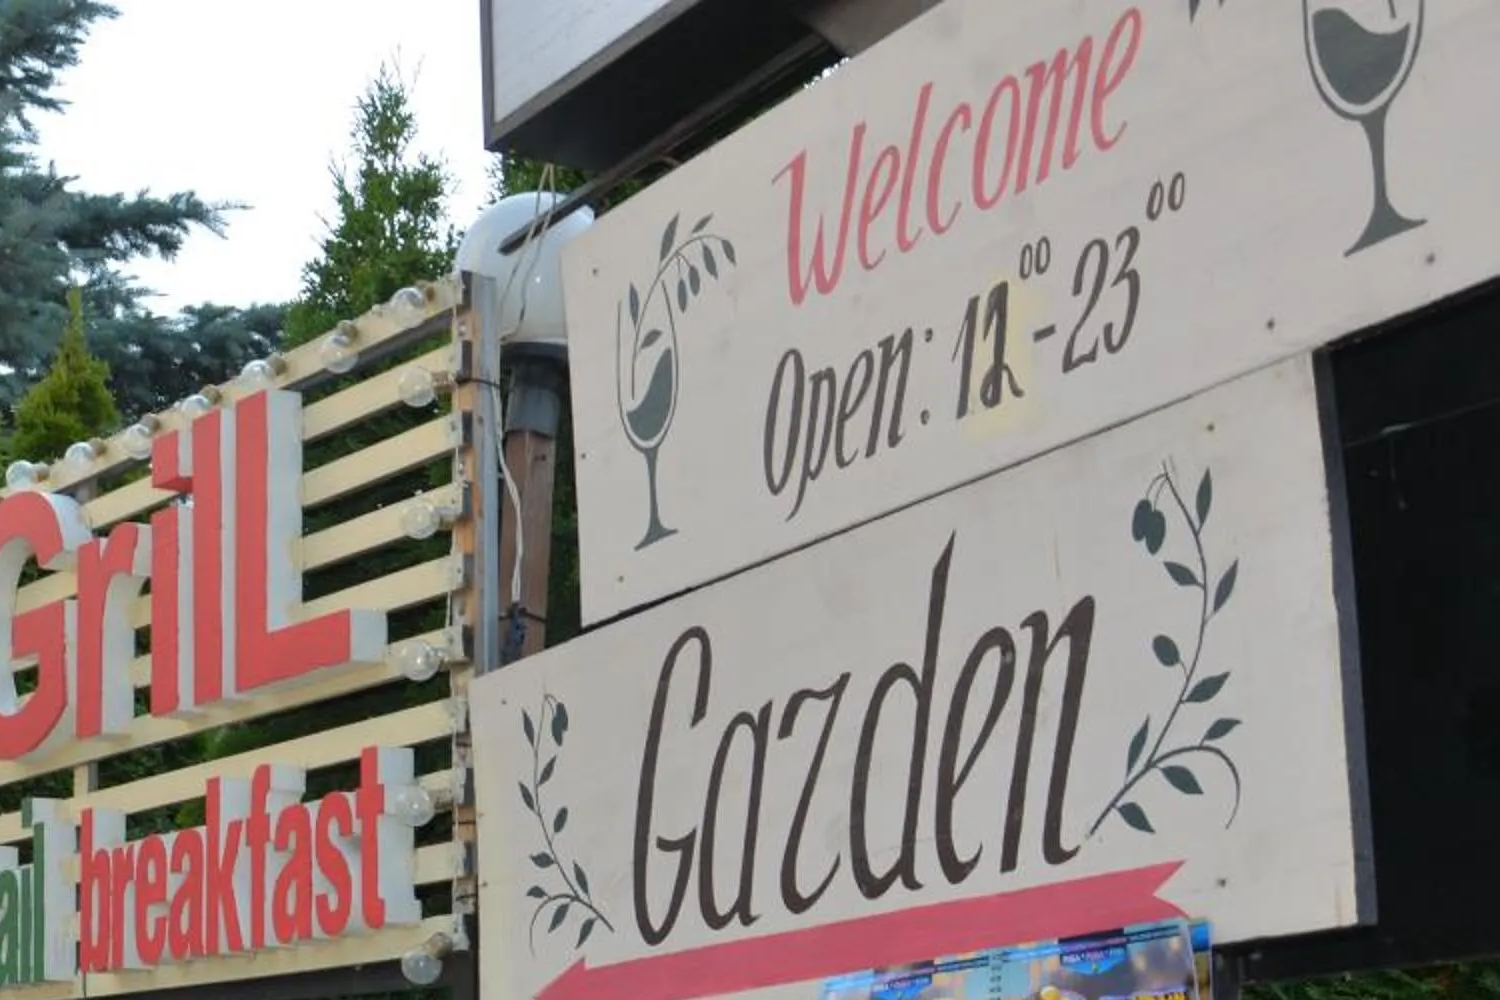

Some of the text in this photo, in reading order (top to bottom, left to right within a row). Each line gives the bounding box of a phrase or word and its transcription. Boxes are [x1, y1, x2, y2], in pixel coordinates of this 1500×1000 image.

[771, 7, 1143, 306] Welcome
[763, 328, 934, 521] Open:
[79, 746, 385, 976] breakfast
